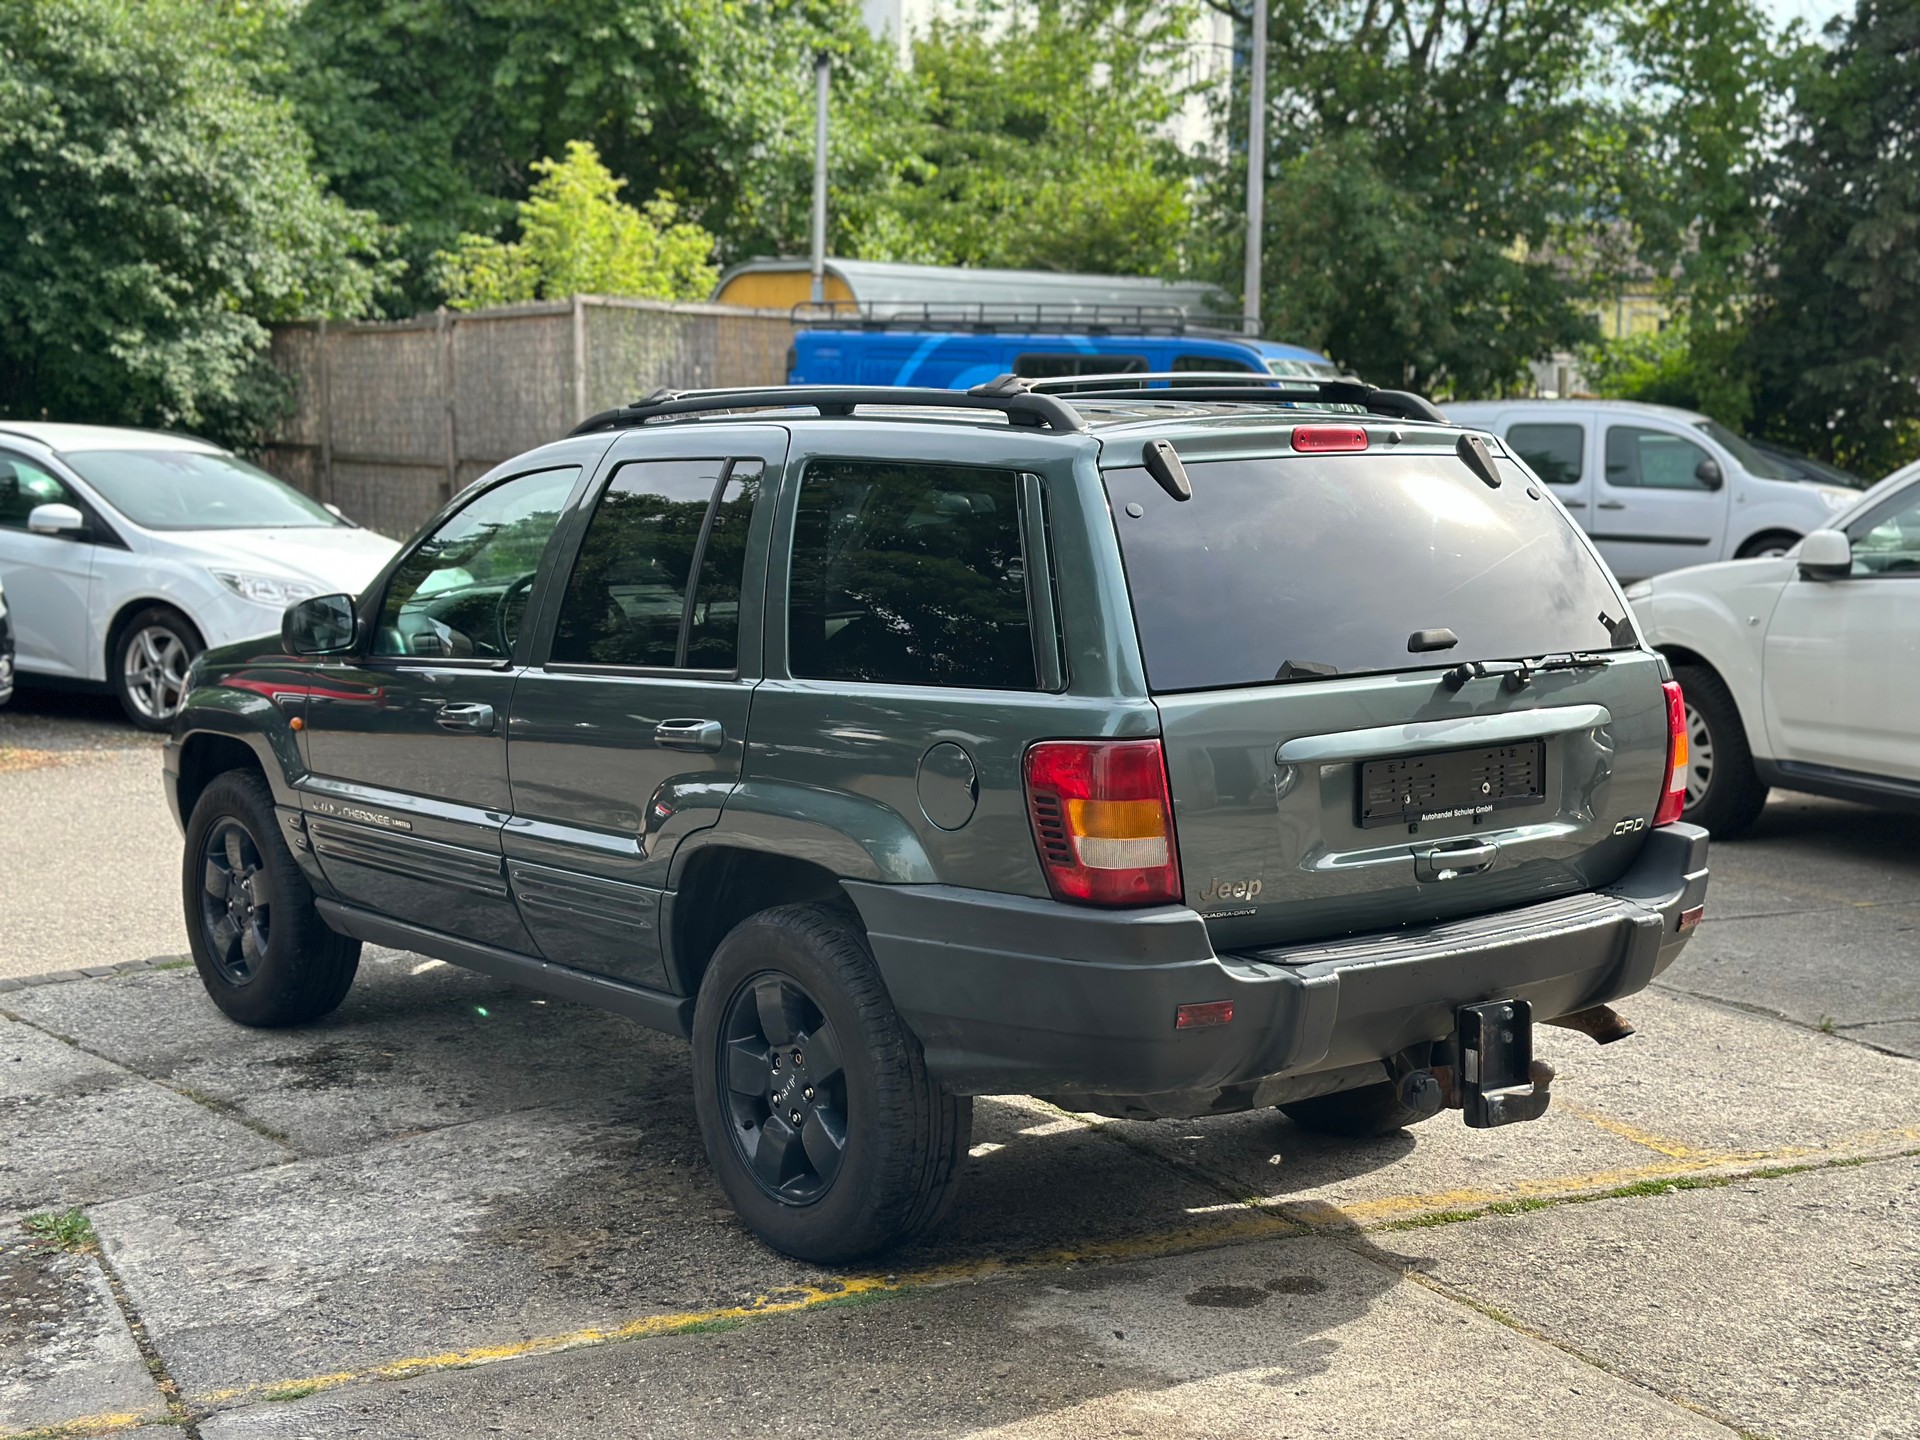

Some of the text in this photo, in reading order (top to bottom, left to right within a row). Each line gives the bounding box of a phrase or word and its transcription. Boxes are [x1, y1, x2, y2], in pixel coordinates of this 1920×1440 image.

[343, 807, 390, 826] CHEROKEE
[1421, 804, 1493, 821] Autohandel Schuler GmbH
[1200, 878, 1262, 901] Jeep
[1201, 908, 1257, 919] QUADRA-DRIVE
